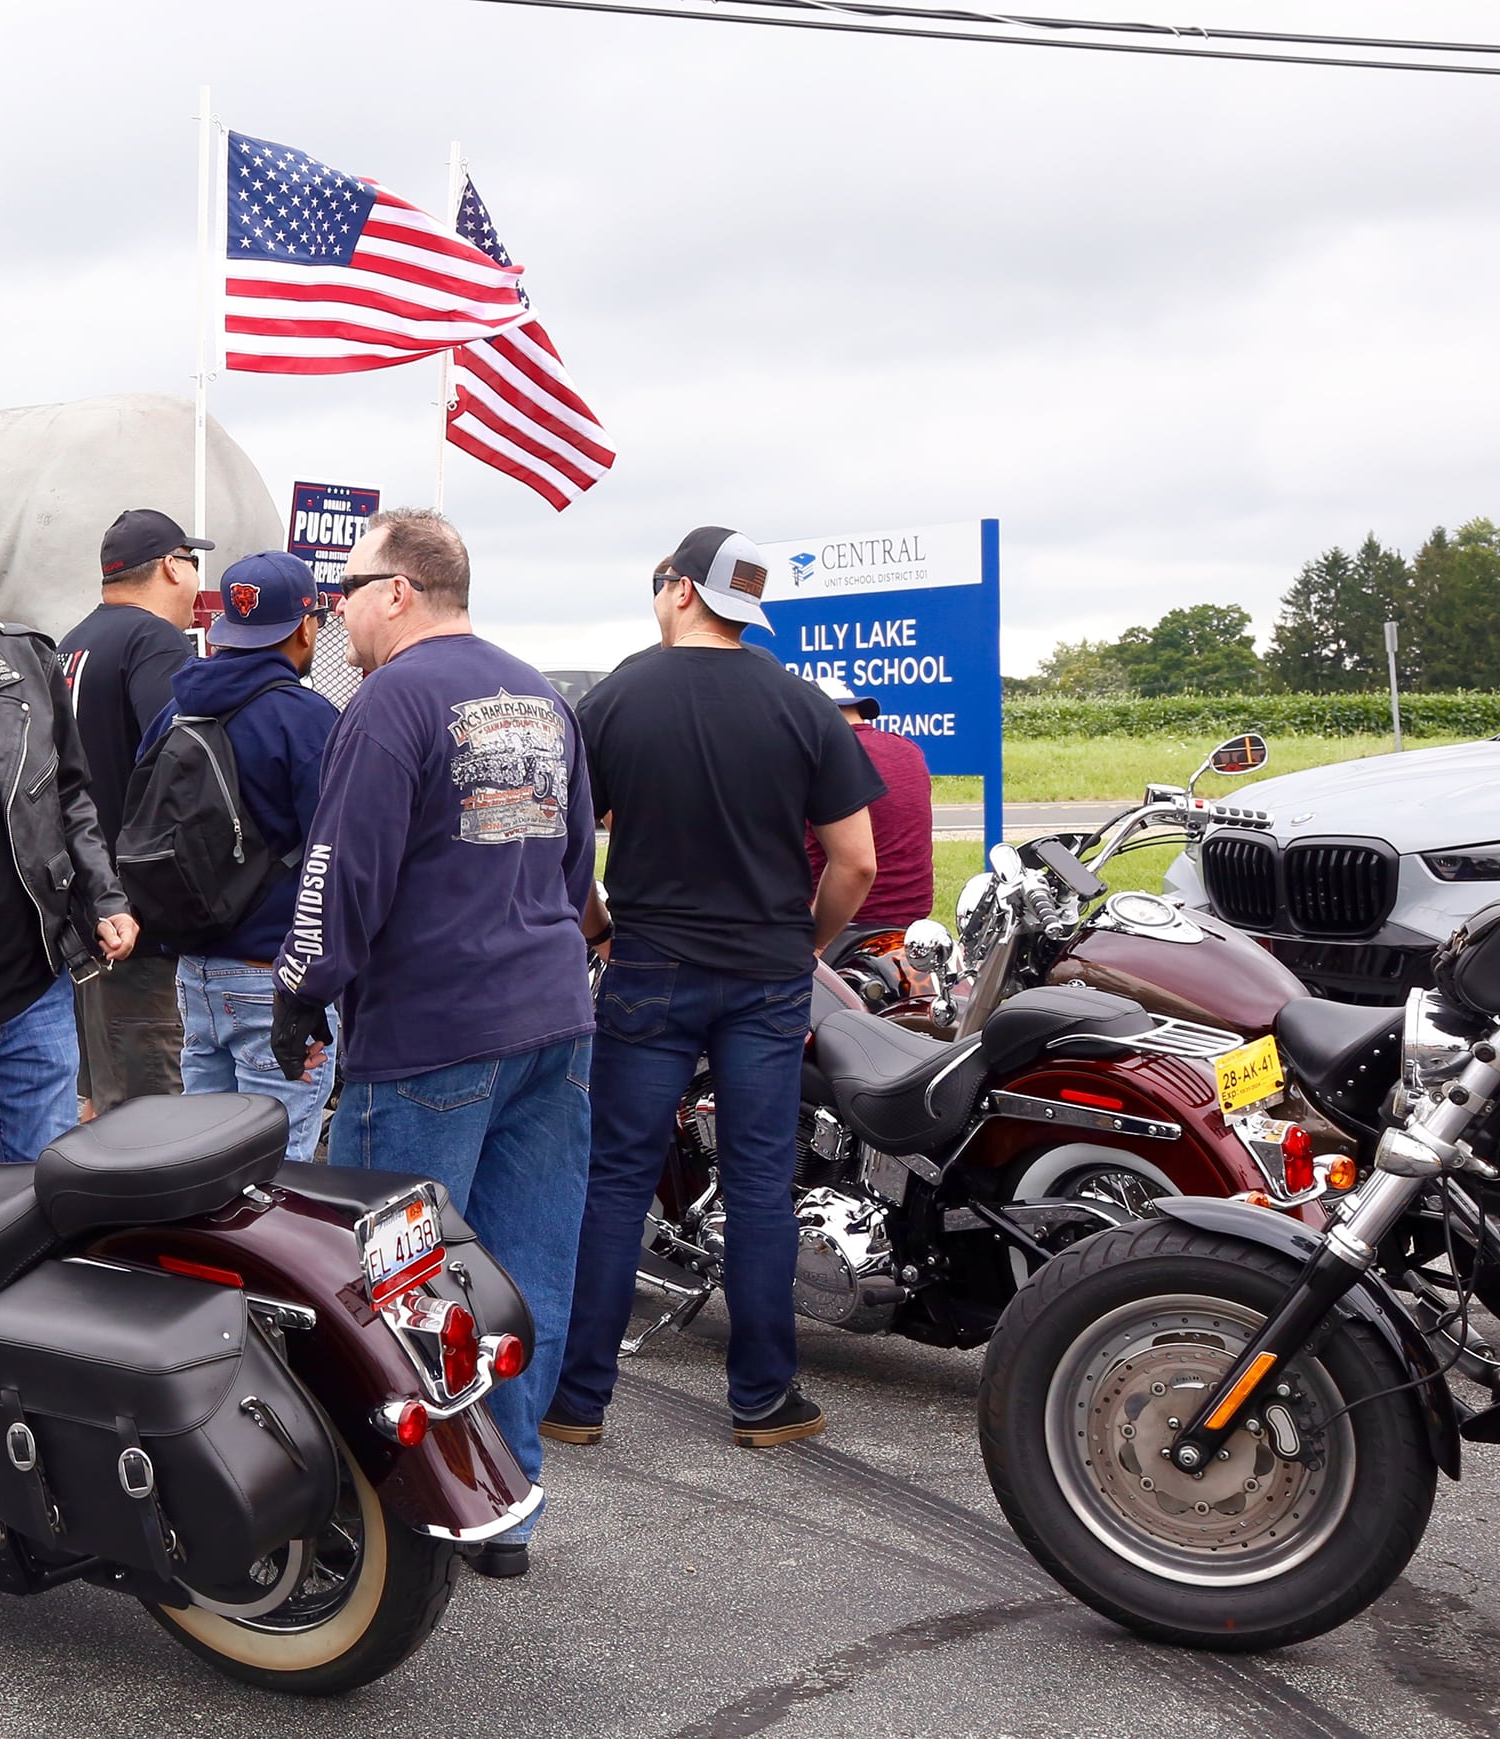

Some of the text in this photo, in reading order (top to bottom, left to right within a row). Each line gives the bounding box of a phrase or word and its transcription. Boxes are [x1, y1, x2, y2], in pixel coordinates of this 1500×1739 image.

[821, 536, 927, 570] CENTRAL
[824, 569, 928, 588] UNIT SCHOOL DISTRICT 301
[801, 619, 917, 651] LILY LAKE
[853, 656, 953, 686] SCHOOL
[1223, 1054, 1274, 1090] 28-AK-41
[1222, 1088, 1239, 1101] Exp:
[369, 1247, 391, 1279] EL
[396, 1219, 435, 1263] 4138
